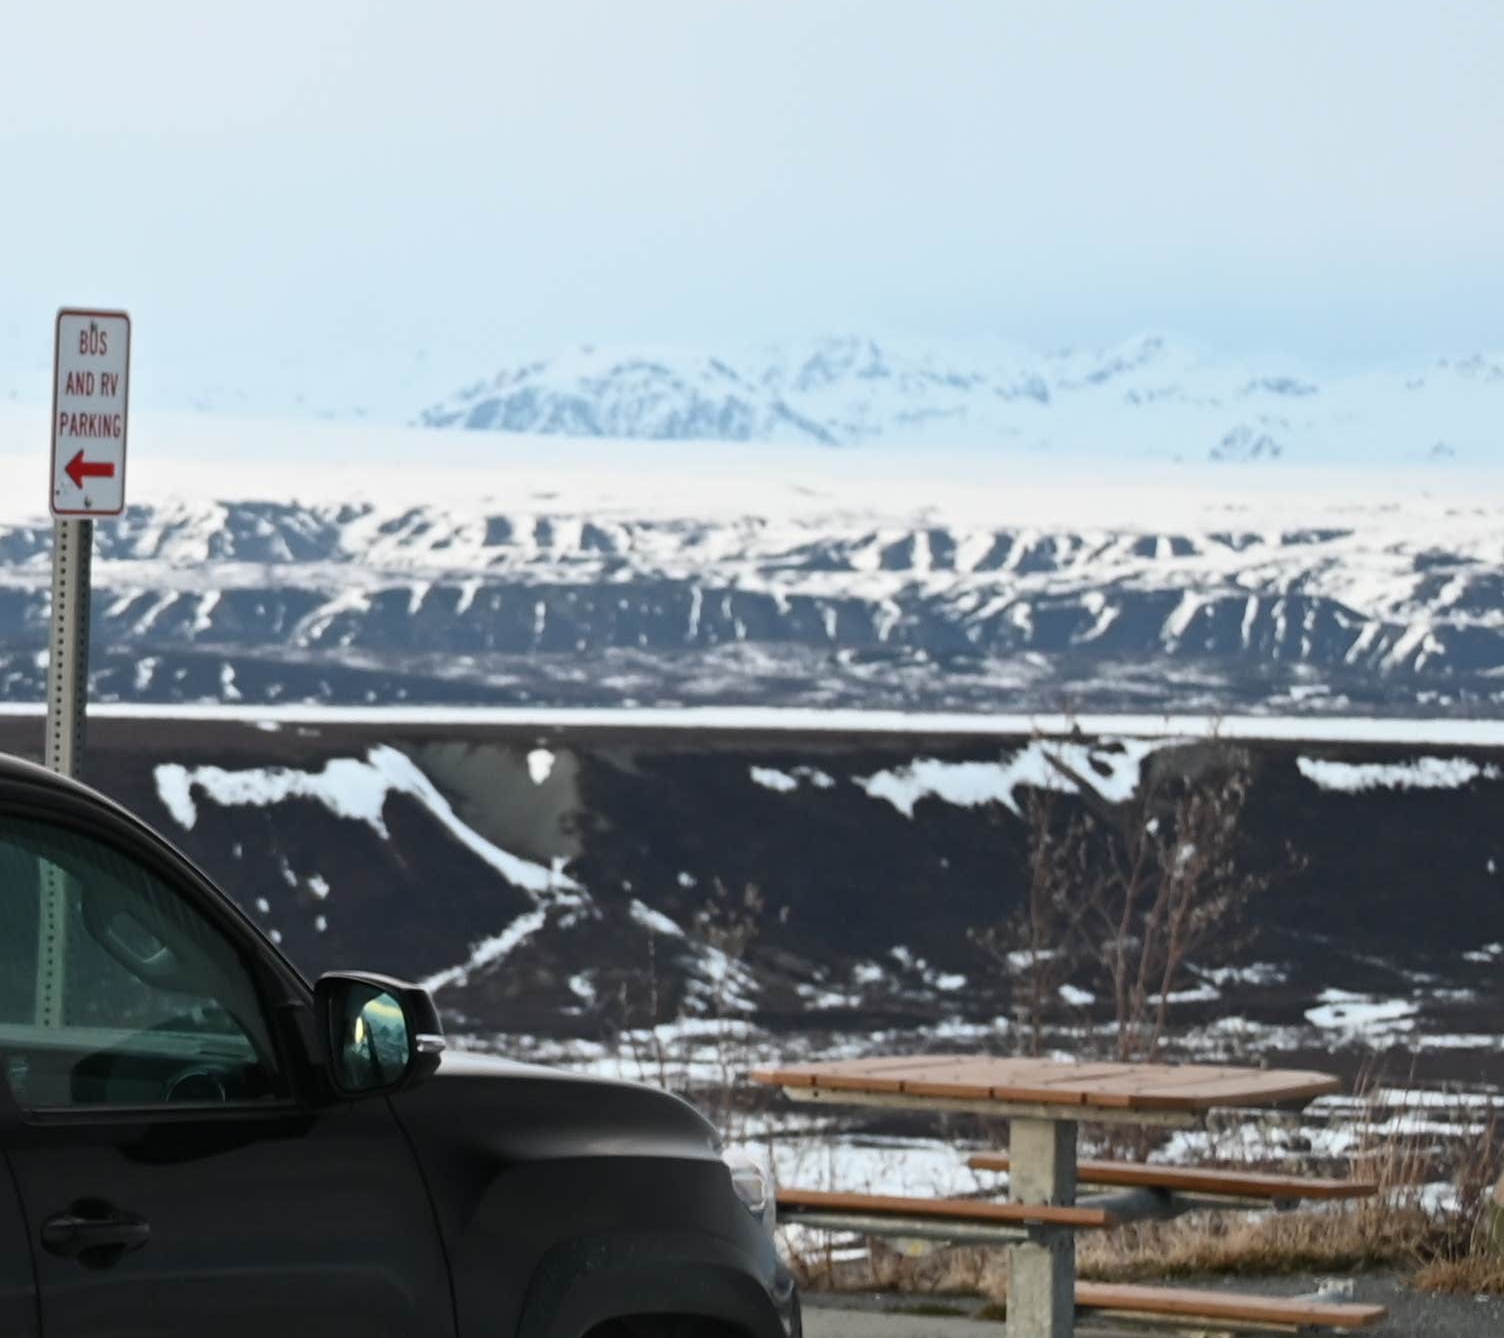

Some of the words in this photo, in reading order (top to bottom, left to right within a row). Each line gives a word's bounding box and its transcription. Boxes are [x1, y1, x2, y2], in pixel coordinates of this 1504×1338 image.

[79, 330, 108, 355] BUS
[65, 371, 95, 397] AND
[100, 372, 119, 397] RV
[59, 412, 121, 438] PARKING
